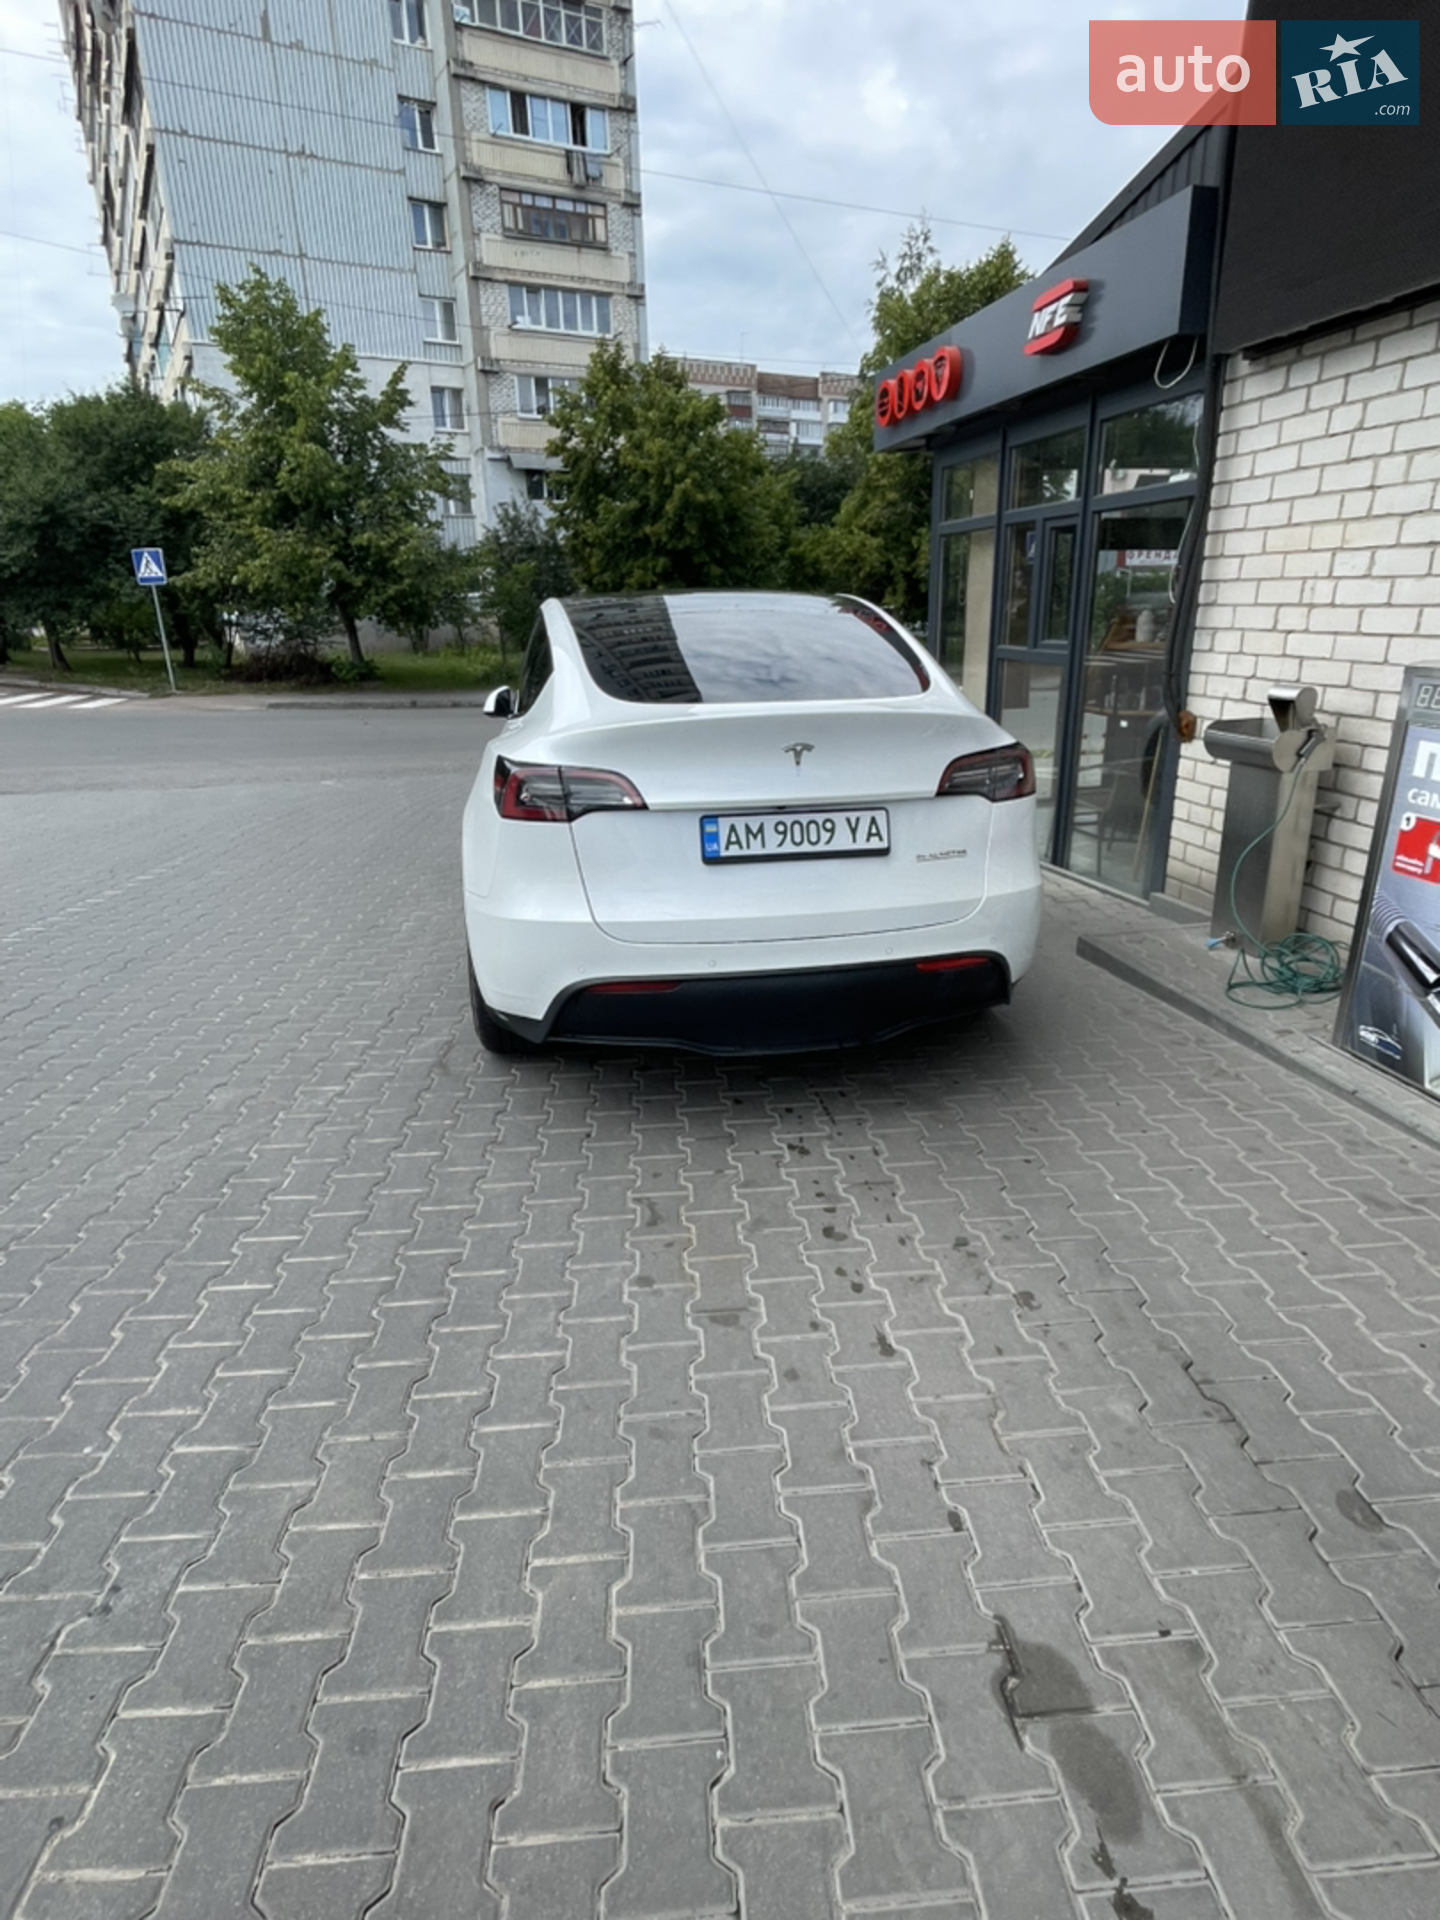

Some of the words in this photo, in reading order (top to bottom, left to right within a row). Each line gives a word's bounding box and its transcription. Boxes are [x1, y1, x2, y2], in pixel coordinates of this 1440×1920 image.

[724, 822, 766, 851] AM
[773, 818, 836, 848] 9009
[845, 815, 884, 844] YA
